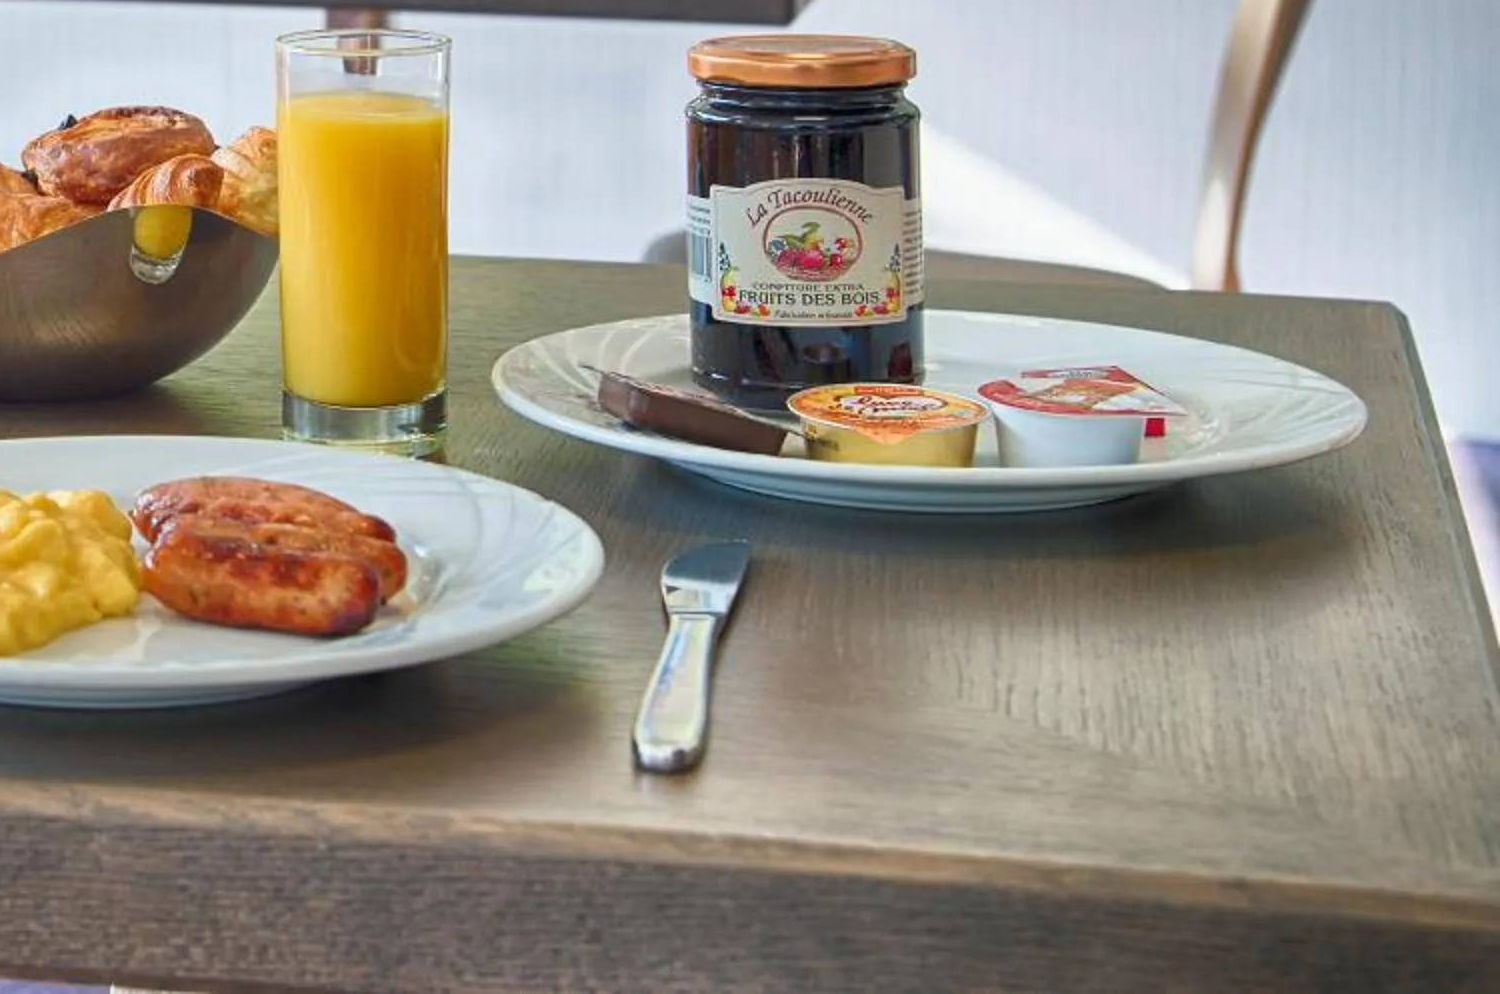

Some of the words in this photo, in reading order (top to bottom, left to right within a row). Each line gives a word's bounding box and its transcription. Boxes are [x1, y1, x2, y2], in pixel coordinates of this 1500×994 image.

[746, 200, 769, 228] La
[768, 188, 876, 226] Tacoulienne
[739, 289, 797, 306] FRUITS
[801, 292, 836, 307] DES
[841, 291, 880, 306] BOIS
